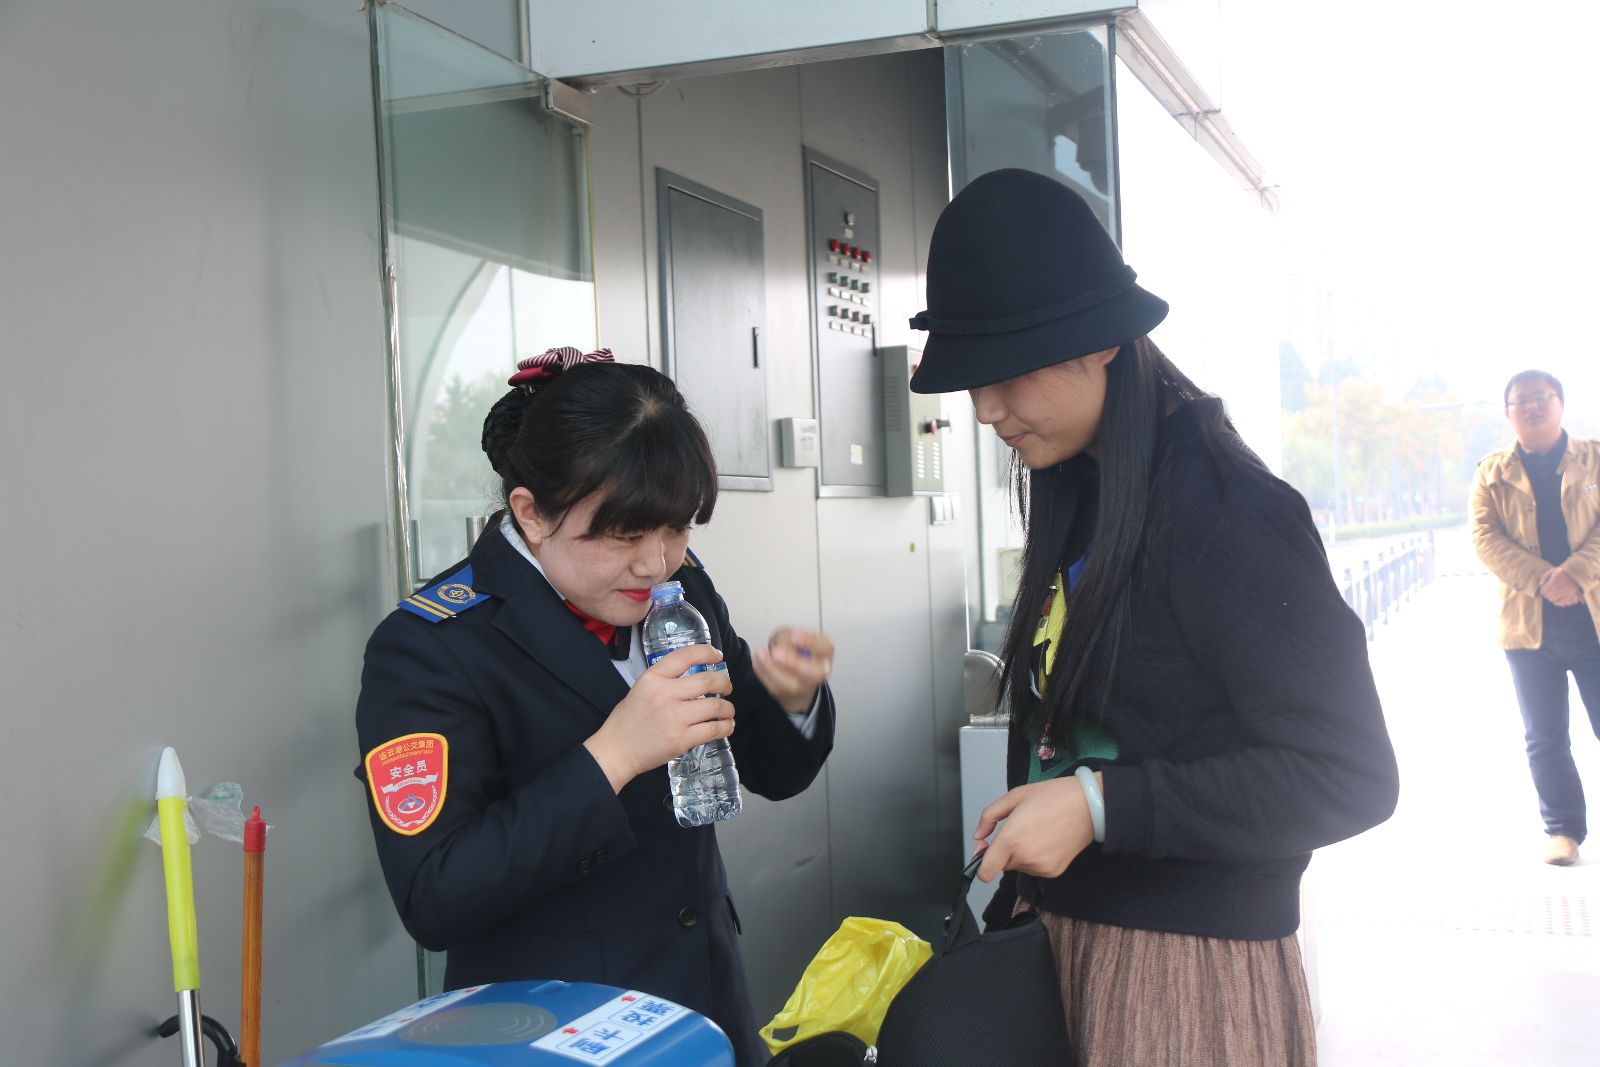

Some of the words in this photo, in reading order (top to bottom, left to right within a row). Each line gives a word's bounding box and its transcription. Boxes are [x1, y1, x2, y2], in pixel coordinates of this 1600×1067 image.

[390, 760, 427, 779] 安全员
[622, 1000, 675, 1026] 投票
[568, 1028, 624, 1054] 刷卡
